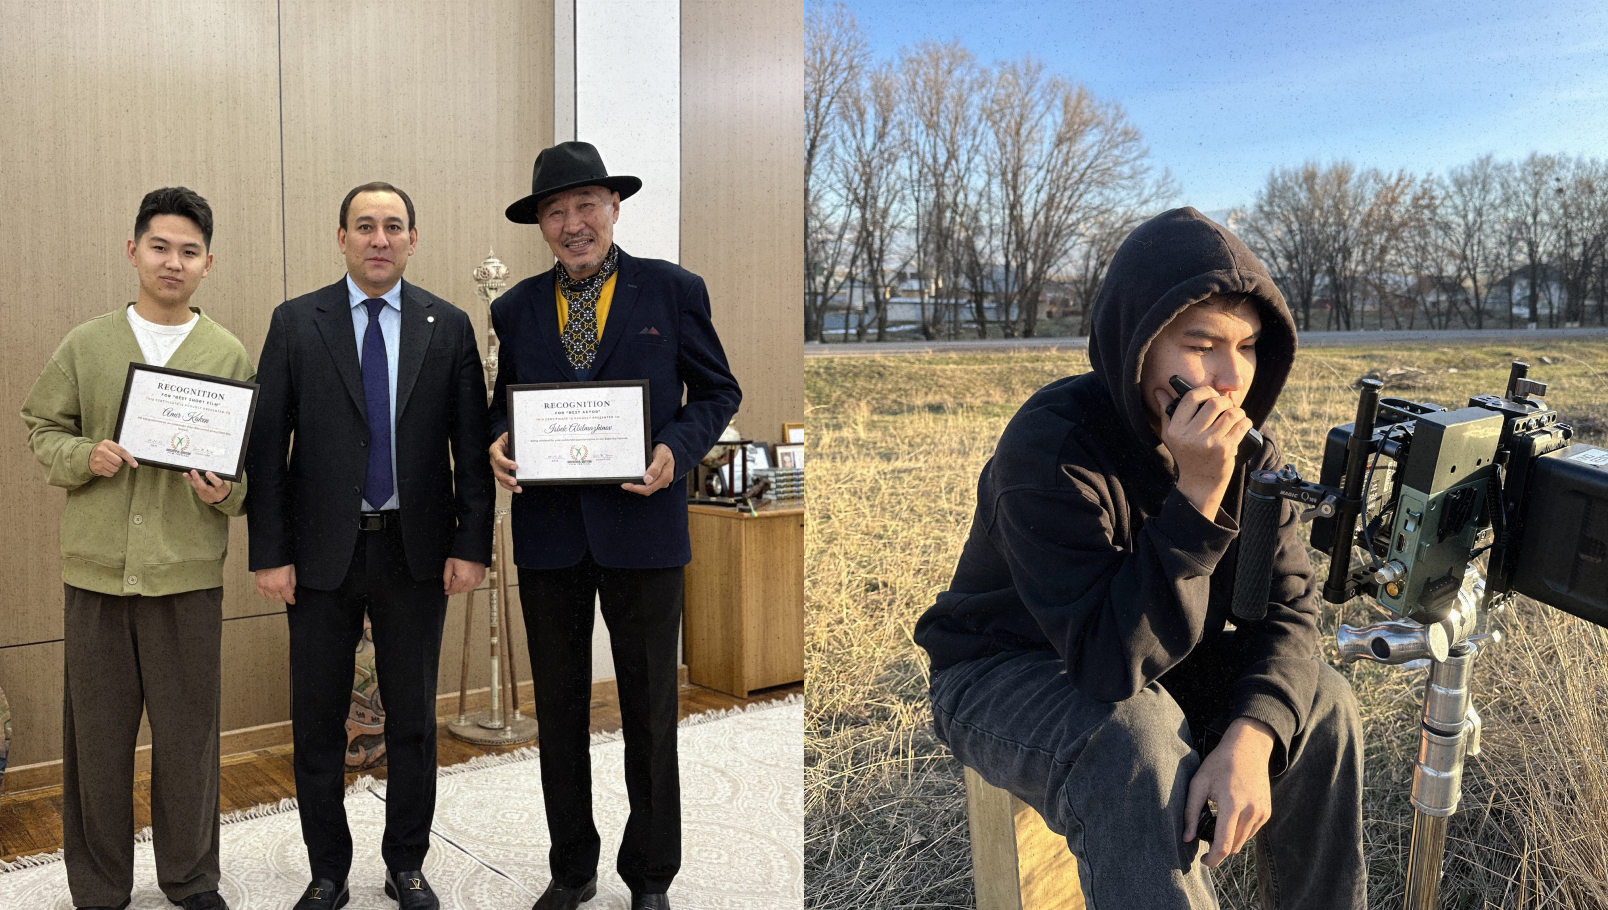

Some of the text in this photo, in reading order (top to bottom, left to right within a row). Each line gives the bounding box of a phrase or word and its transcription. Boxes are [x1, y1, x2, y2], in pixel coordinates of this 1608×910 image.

[158, 383, 225, 400] RECOGNITION
[544, 400, 611, 409] RECOGNITION
[1280, 490, 1298, 498] MAGIC
